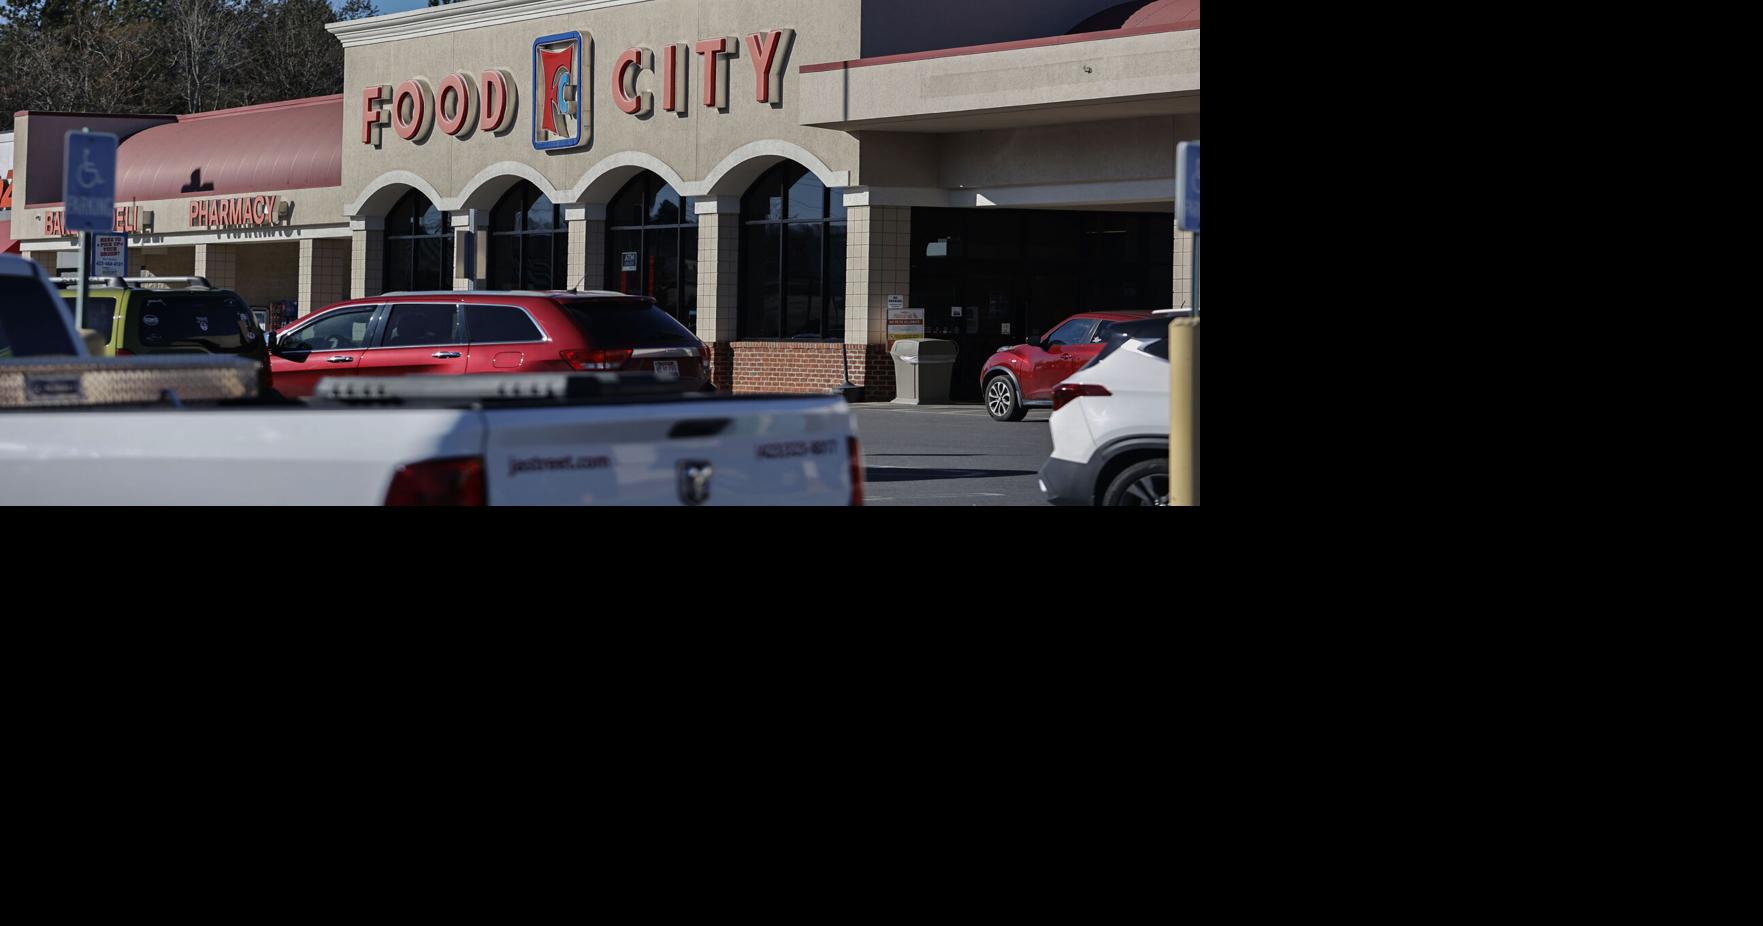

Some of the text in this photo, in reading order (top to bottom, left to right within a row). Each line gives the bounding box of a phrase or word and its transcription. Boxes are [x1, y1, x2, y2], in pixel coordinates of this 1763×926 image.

[361, 28, 790, 145] FOOD CITY
[113, 206, 138, 232] ELI
[189, 195, 277, 227] PHARMACY
